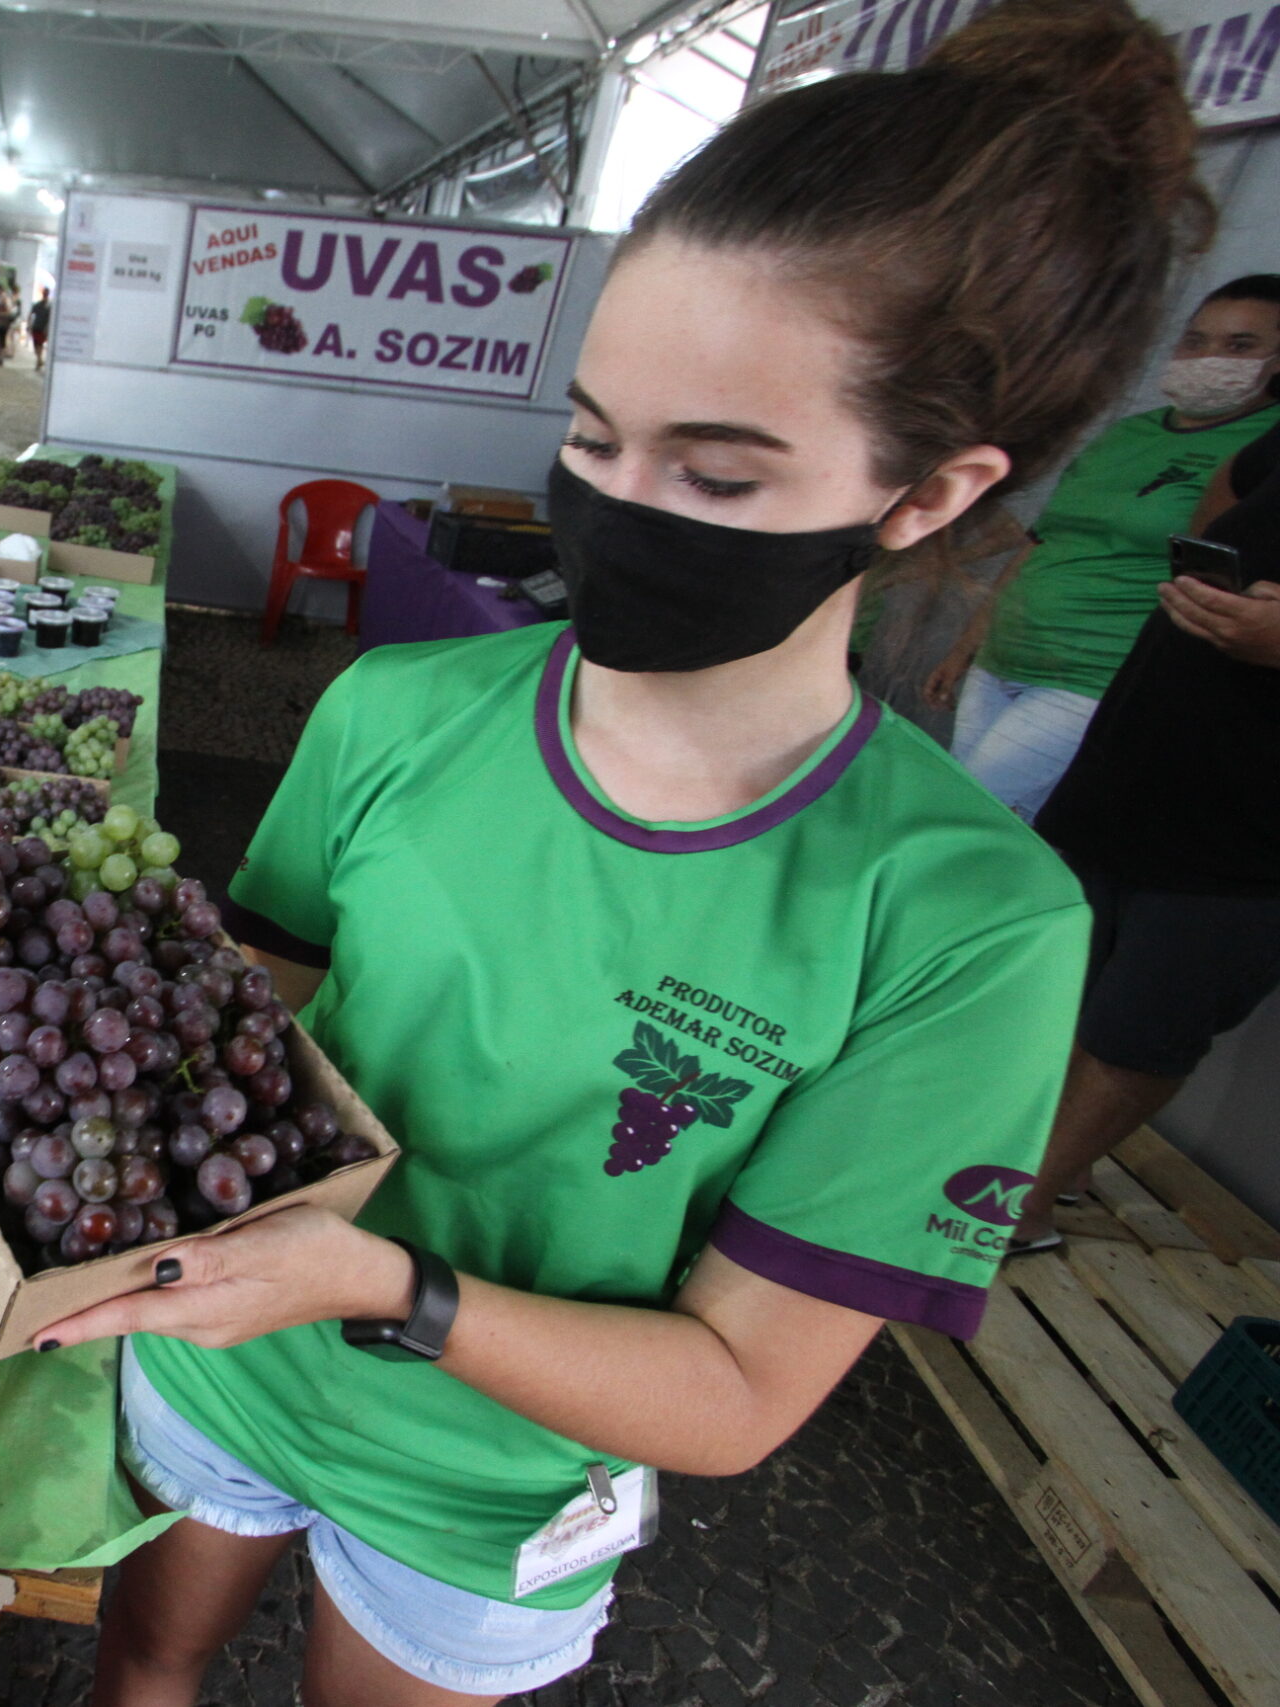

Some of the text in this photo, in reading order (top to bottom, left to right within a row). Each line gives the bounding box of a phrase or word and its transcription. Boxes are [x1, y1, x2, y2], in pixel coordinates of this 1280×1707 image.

[207, 224, 259, 250] AQUI
[193, 243, 278, 276] VENDAS
[280, 229, 506, 308] UVAS
[185, 305, 229, 322] UVAS
[194, 323, 216, 338] PG
[311, 323, 531, 377] A. SOZIM
[656, 975, 788, 1046] PRODUTOR
[613, 989, 804, 1083] ADEMAR SOZIM
[926, 1213, 970, 1242] Mil
[519, 1555, 588, 1592] EXPOSITOR
